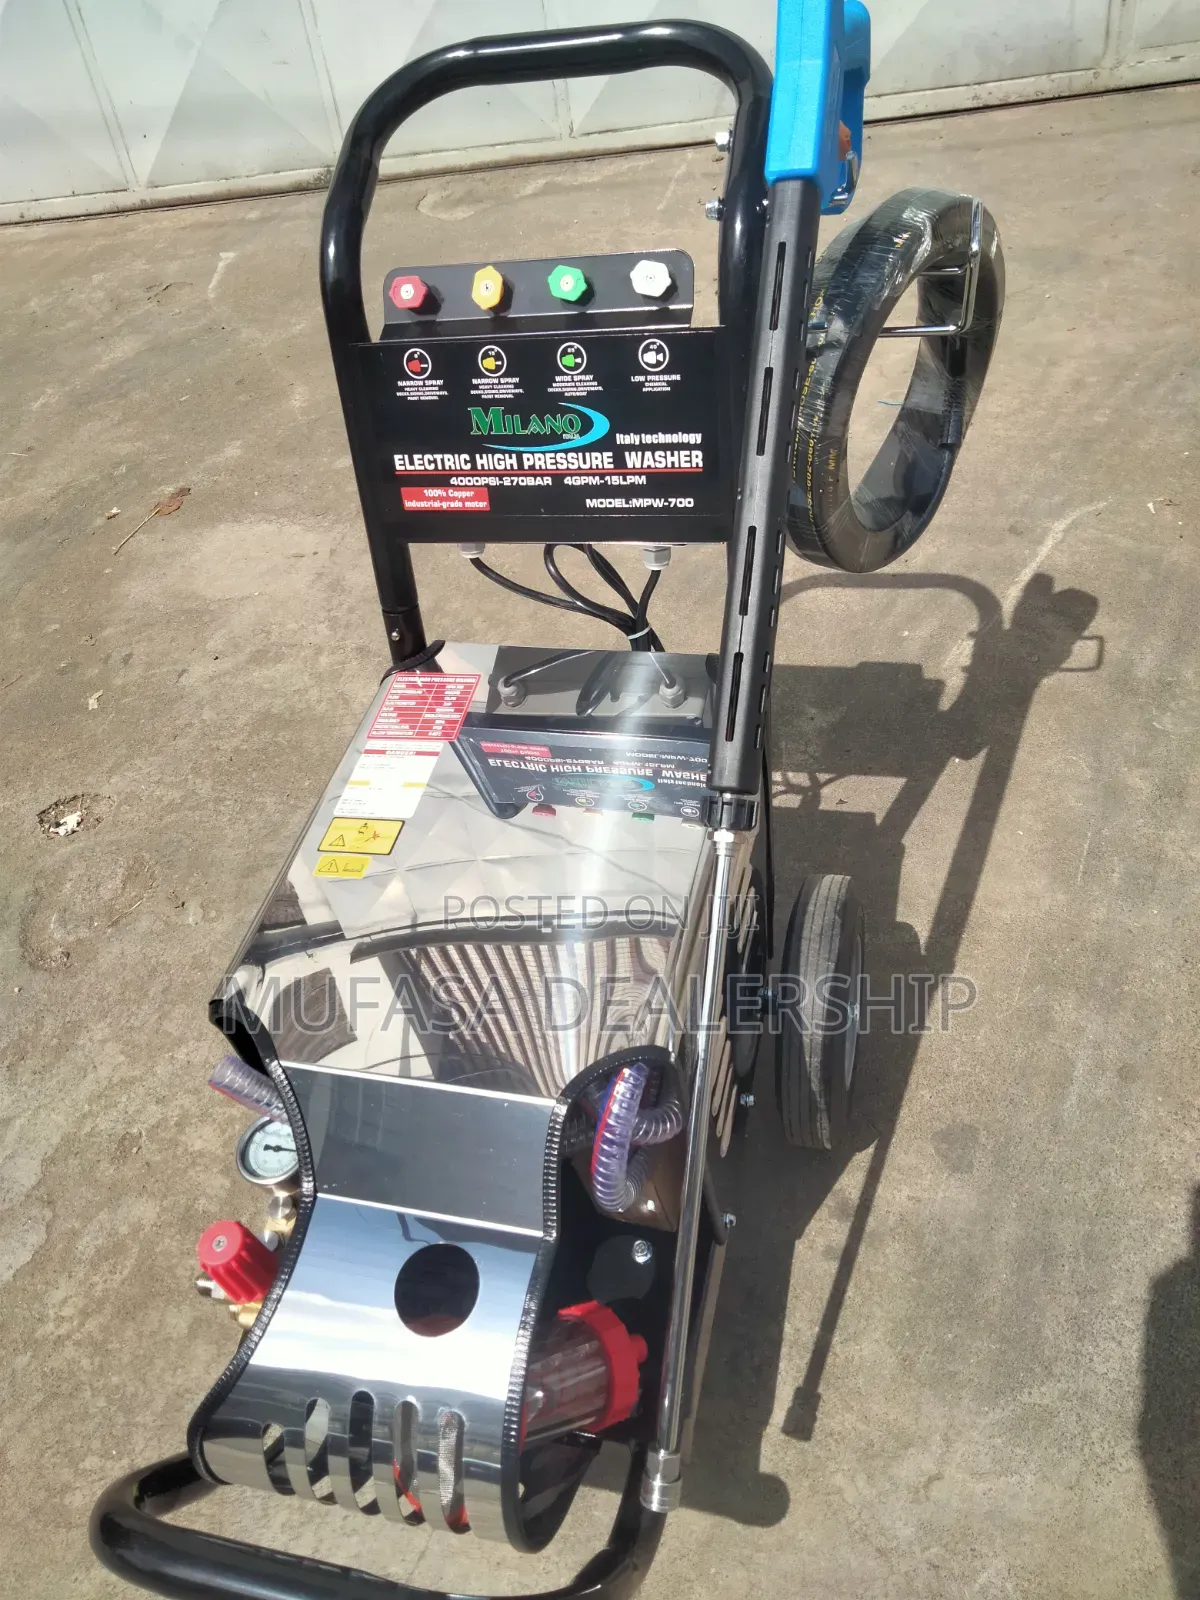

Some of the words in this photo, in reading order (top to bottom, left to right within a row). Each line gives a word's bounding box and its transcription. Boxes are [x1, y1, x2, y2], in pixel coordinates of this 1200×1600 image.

[616, 433, 640, 446] Italy
[641, 431, 702, 445] technology
[393, 454, 472, 471] ELECTRIC
[475, 453, 518, 470] HIGH
[522, 451, 614, 470] PRESSURE
[624, 450, 703, 469] WASHER
[449, 476, 552, 486] 4000PSI-270BAR
[563, 475, 647, 486] 4GPM-15LPM
[423, 489, 447, 498] 100%
[448, 489, 475, 498] Copper
[404, 500, 463, 509] industrial-grade
[585, 498, 695, 509] MODEL:MPW-700
